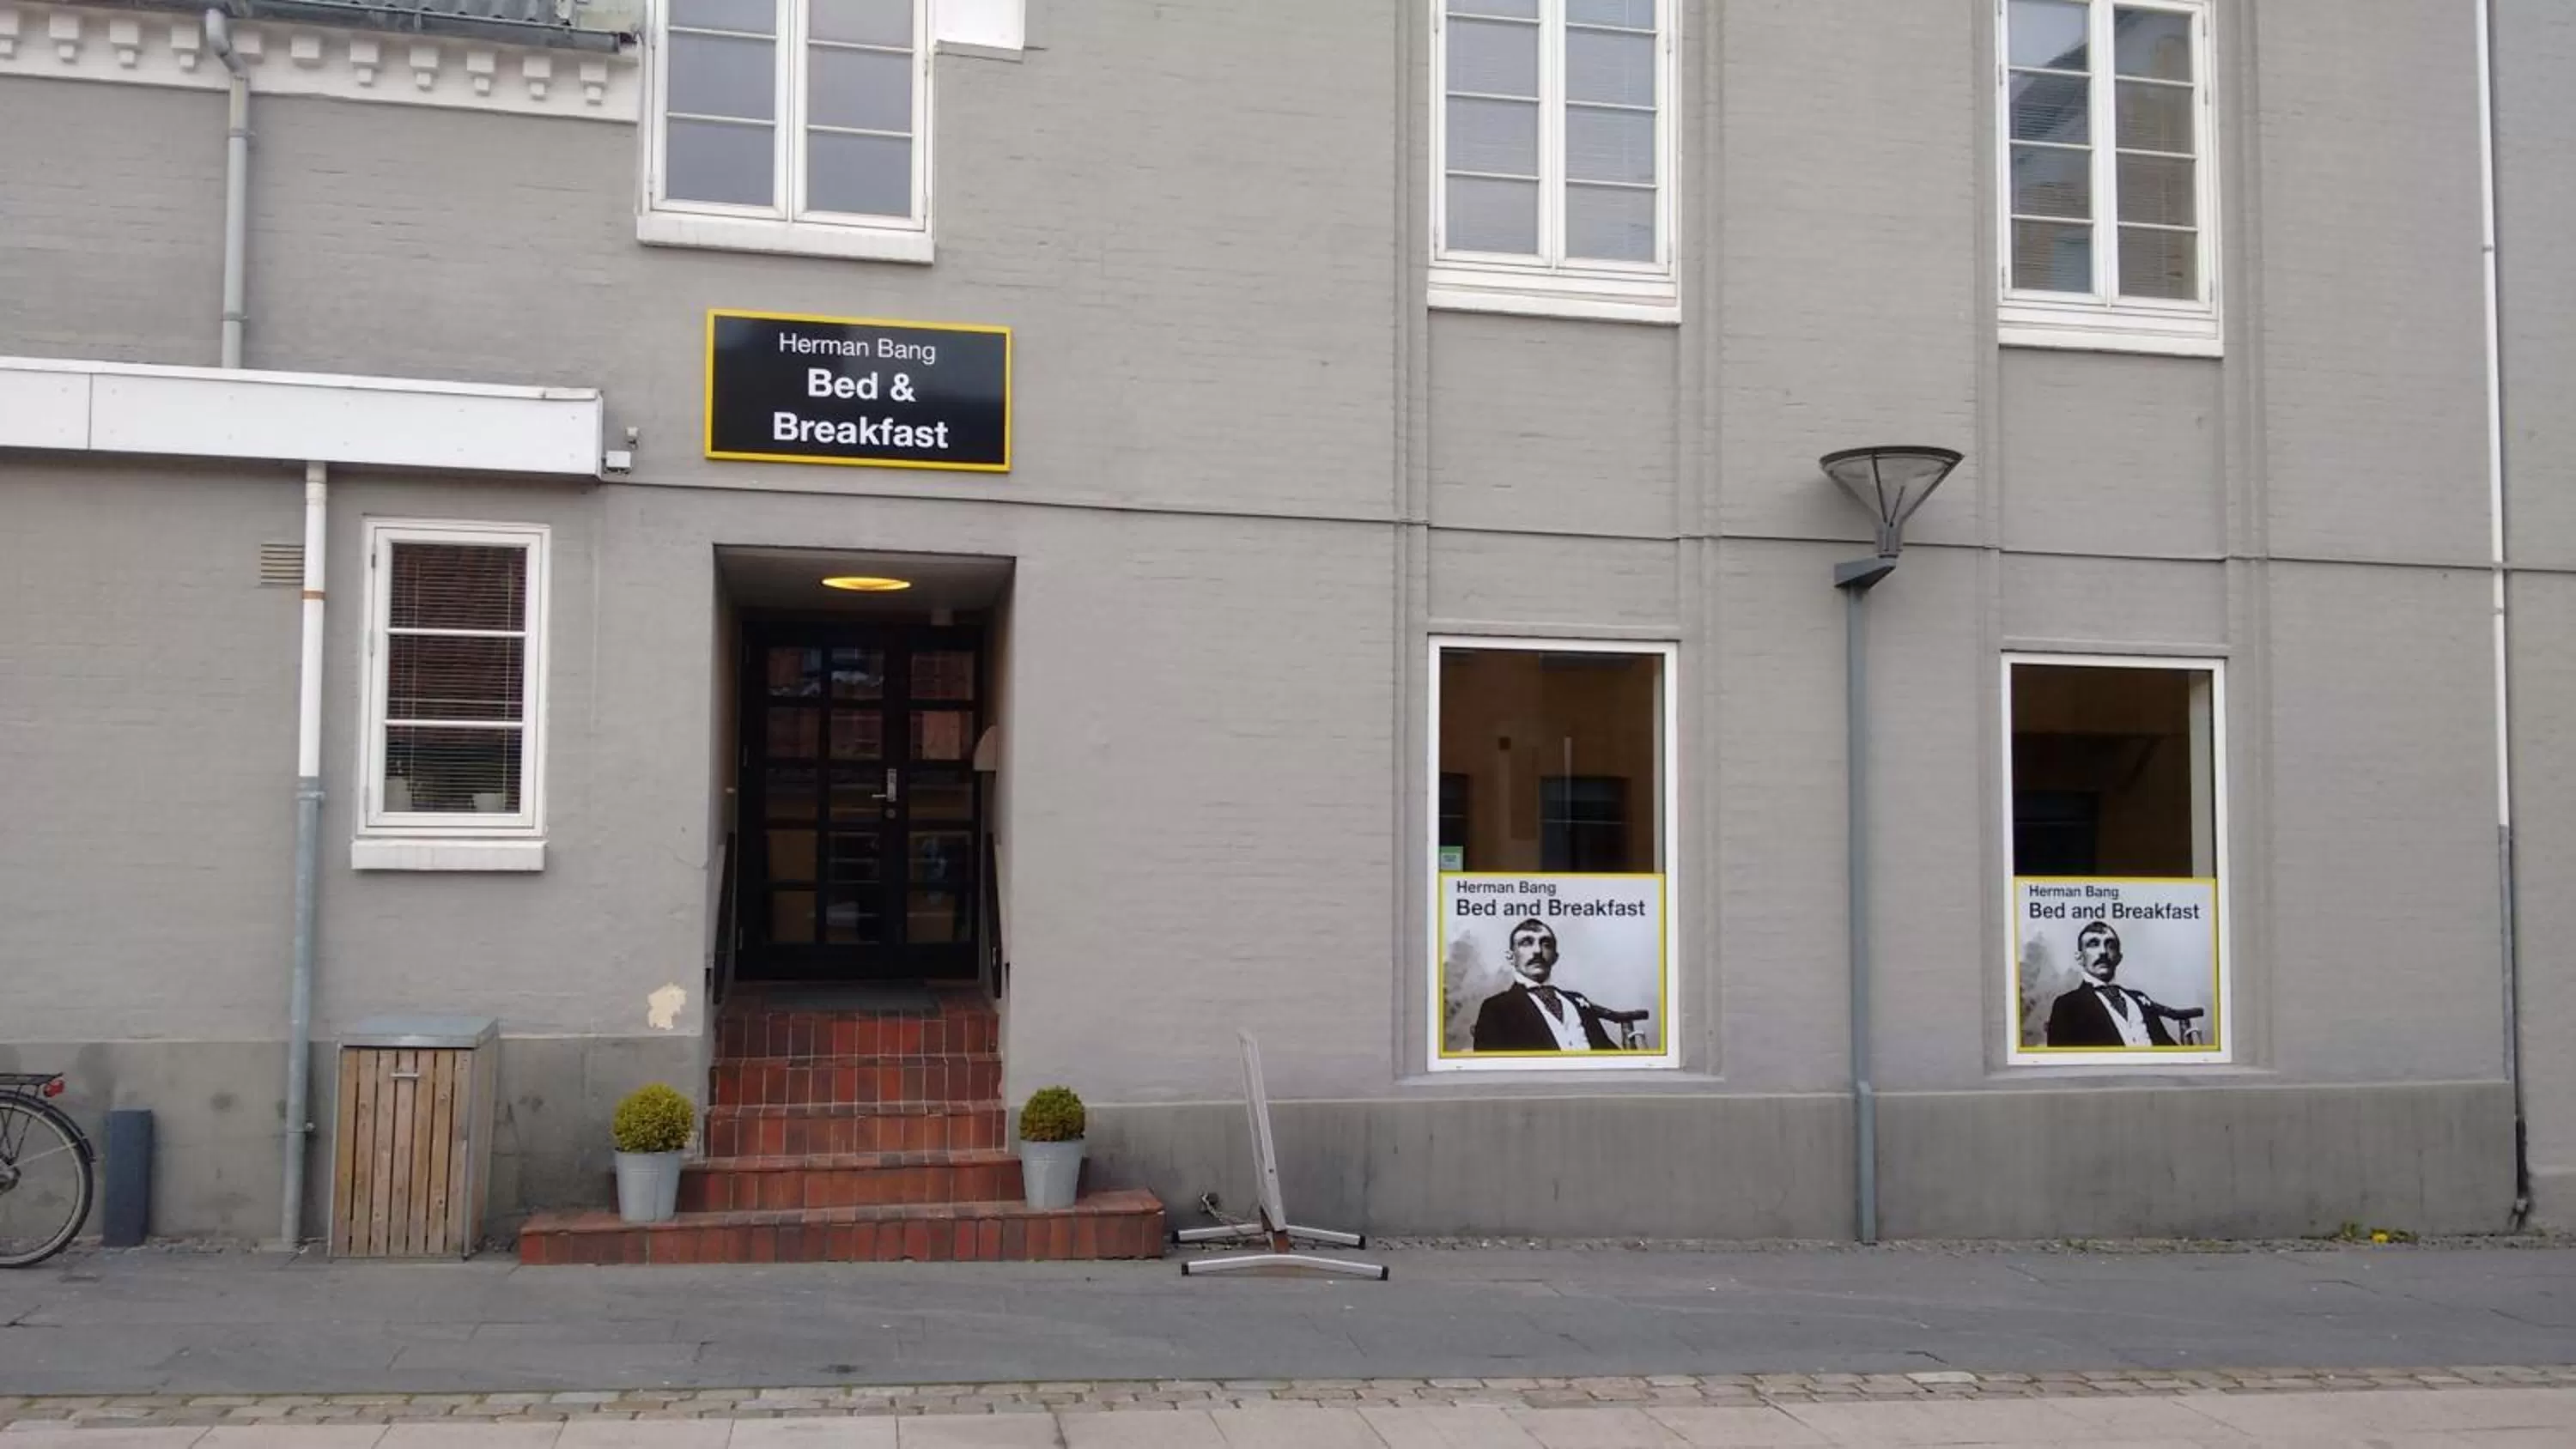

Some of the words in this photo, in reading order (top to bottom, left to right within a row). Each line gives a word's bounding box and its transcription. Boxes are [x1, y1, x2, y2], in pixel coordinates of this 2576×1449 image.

[779, 332, 869, 357] Herman
[878, 338, 936, 365] Bang
[808, 367, 878, 400] Bed
[890, 373, 916, 403] &
[773, 411, 949, 449] Breakfast
[1456, 881, 1514, 894] Herman
[1519, 881, 1557, 896] Bang
[2029, 885, 2081, 897] Herman
[2086, 885, 2119, 900] Bang
[1456, 899, 1496, 916] Bed
[1503, 899, 1541, 916] and
[1548, 899, 1646, 917] Breakfast
[2029, 902, 2065, 919] Bed
[2071, 902, 2105, 919] and
[2111, 902, 2200, 919] Breakfast
